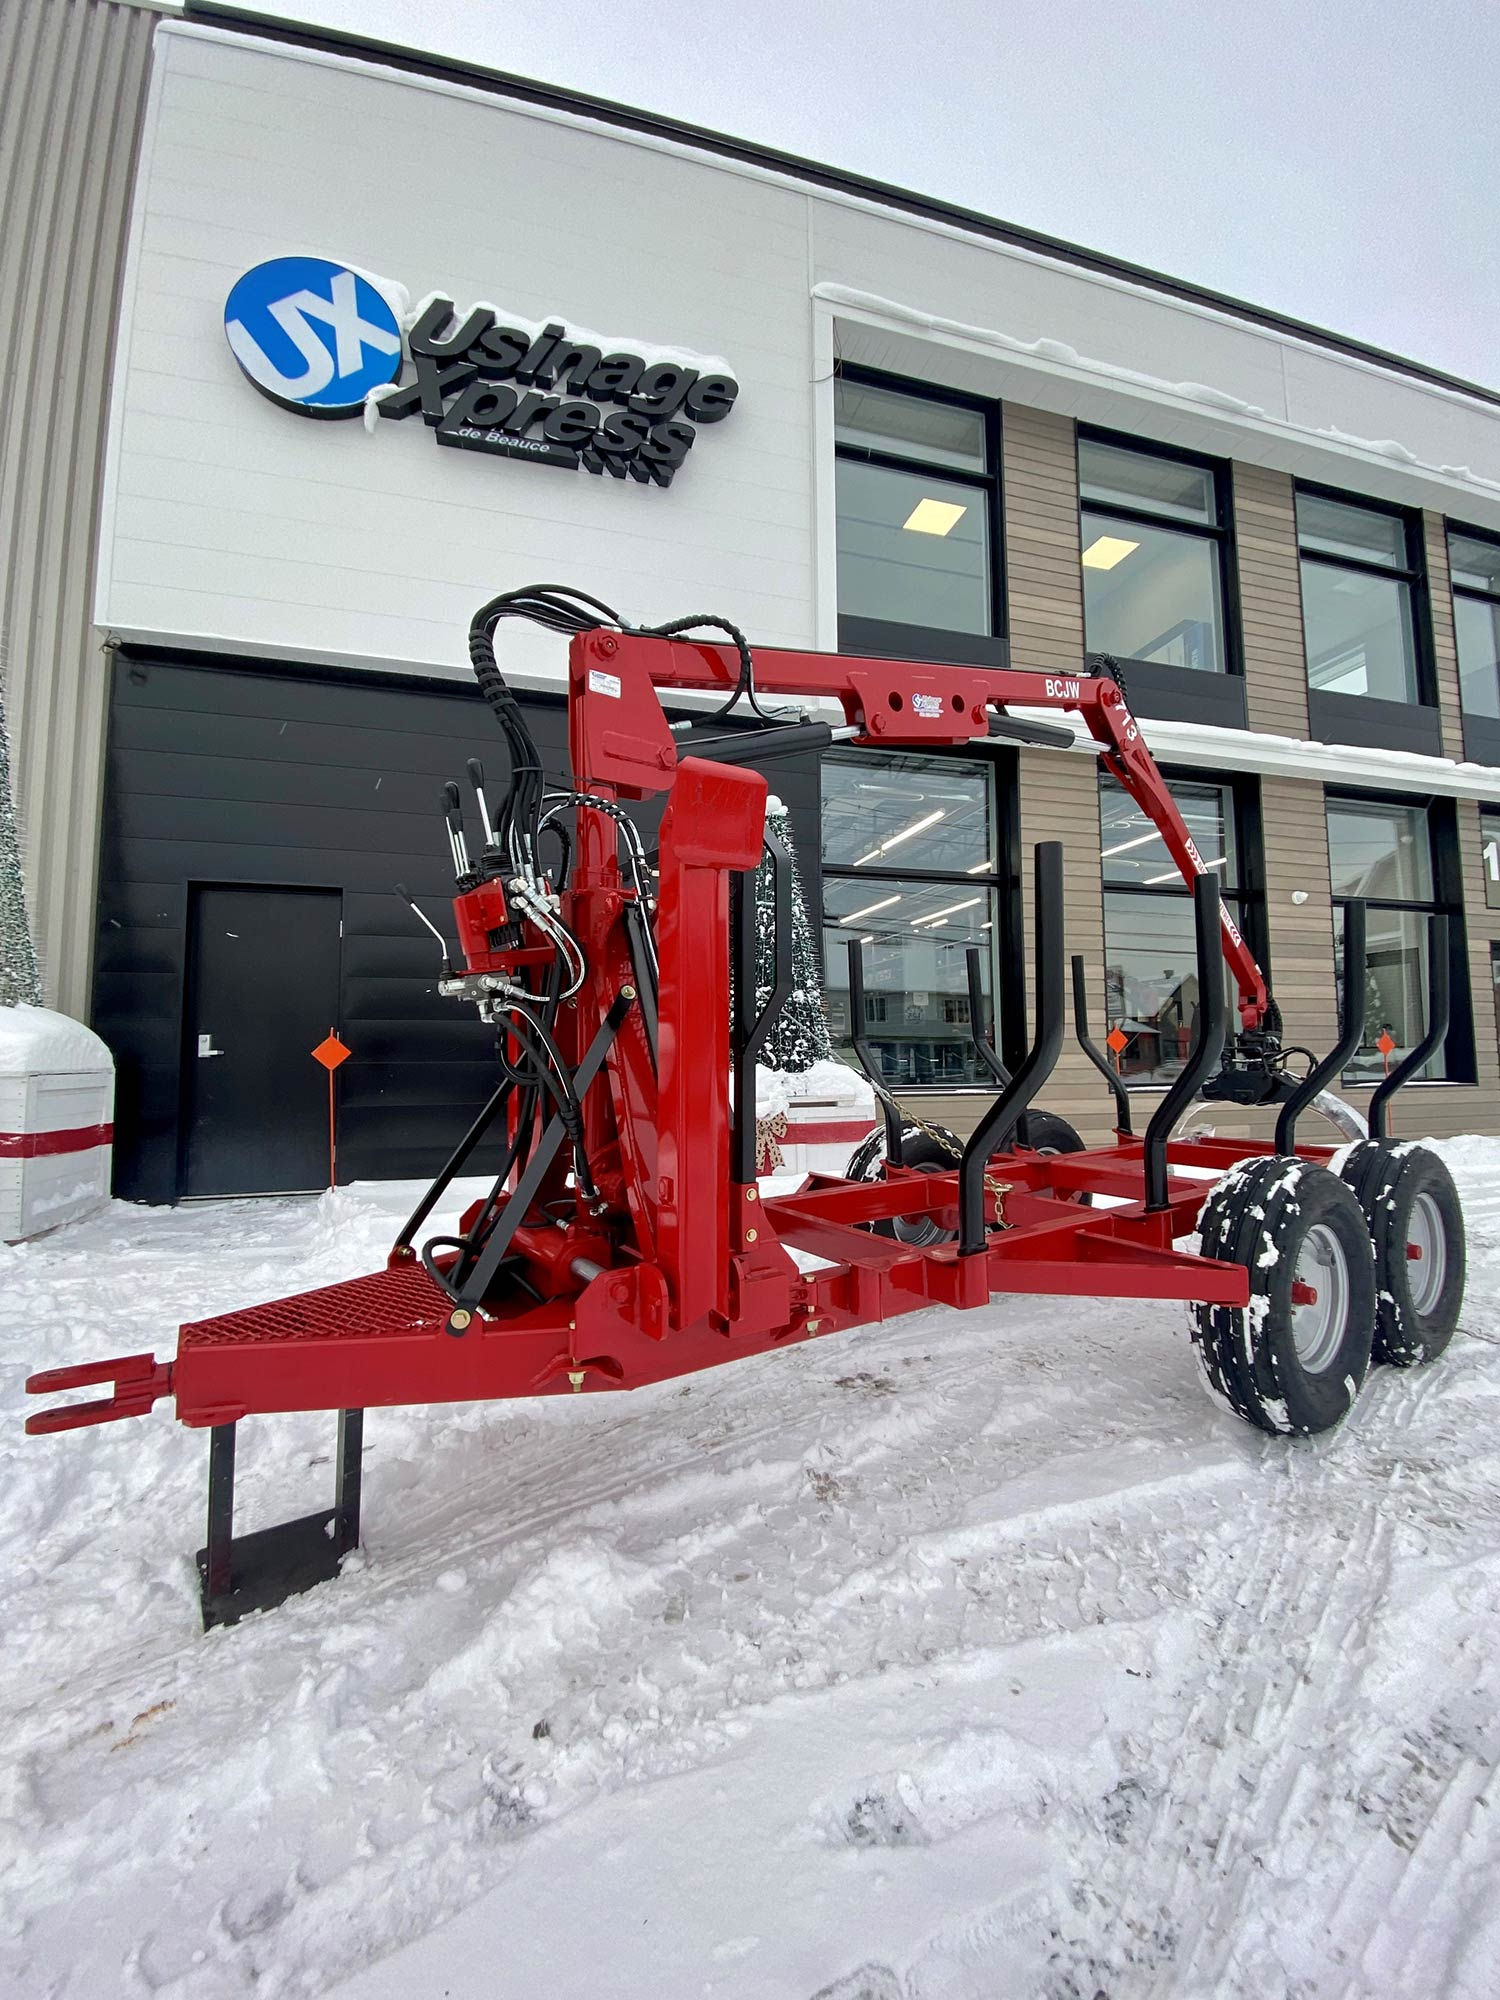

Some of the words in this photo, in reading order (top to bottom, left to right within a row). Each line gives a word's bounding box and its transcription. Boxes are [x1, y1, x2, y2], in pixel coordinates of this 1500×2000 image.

[225, 271, 401, 399] UX
[408, 298, 739, 423] Usinage
[378, 355, 697, 467] Xpress
[458, 427, 481, 439] de
[485, 432, 550, 453] Beauce
[1045, 679, 1080, 699] BCJW
